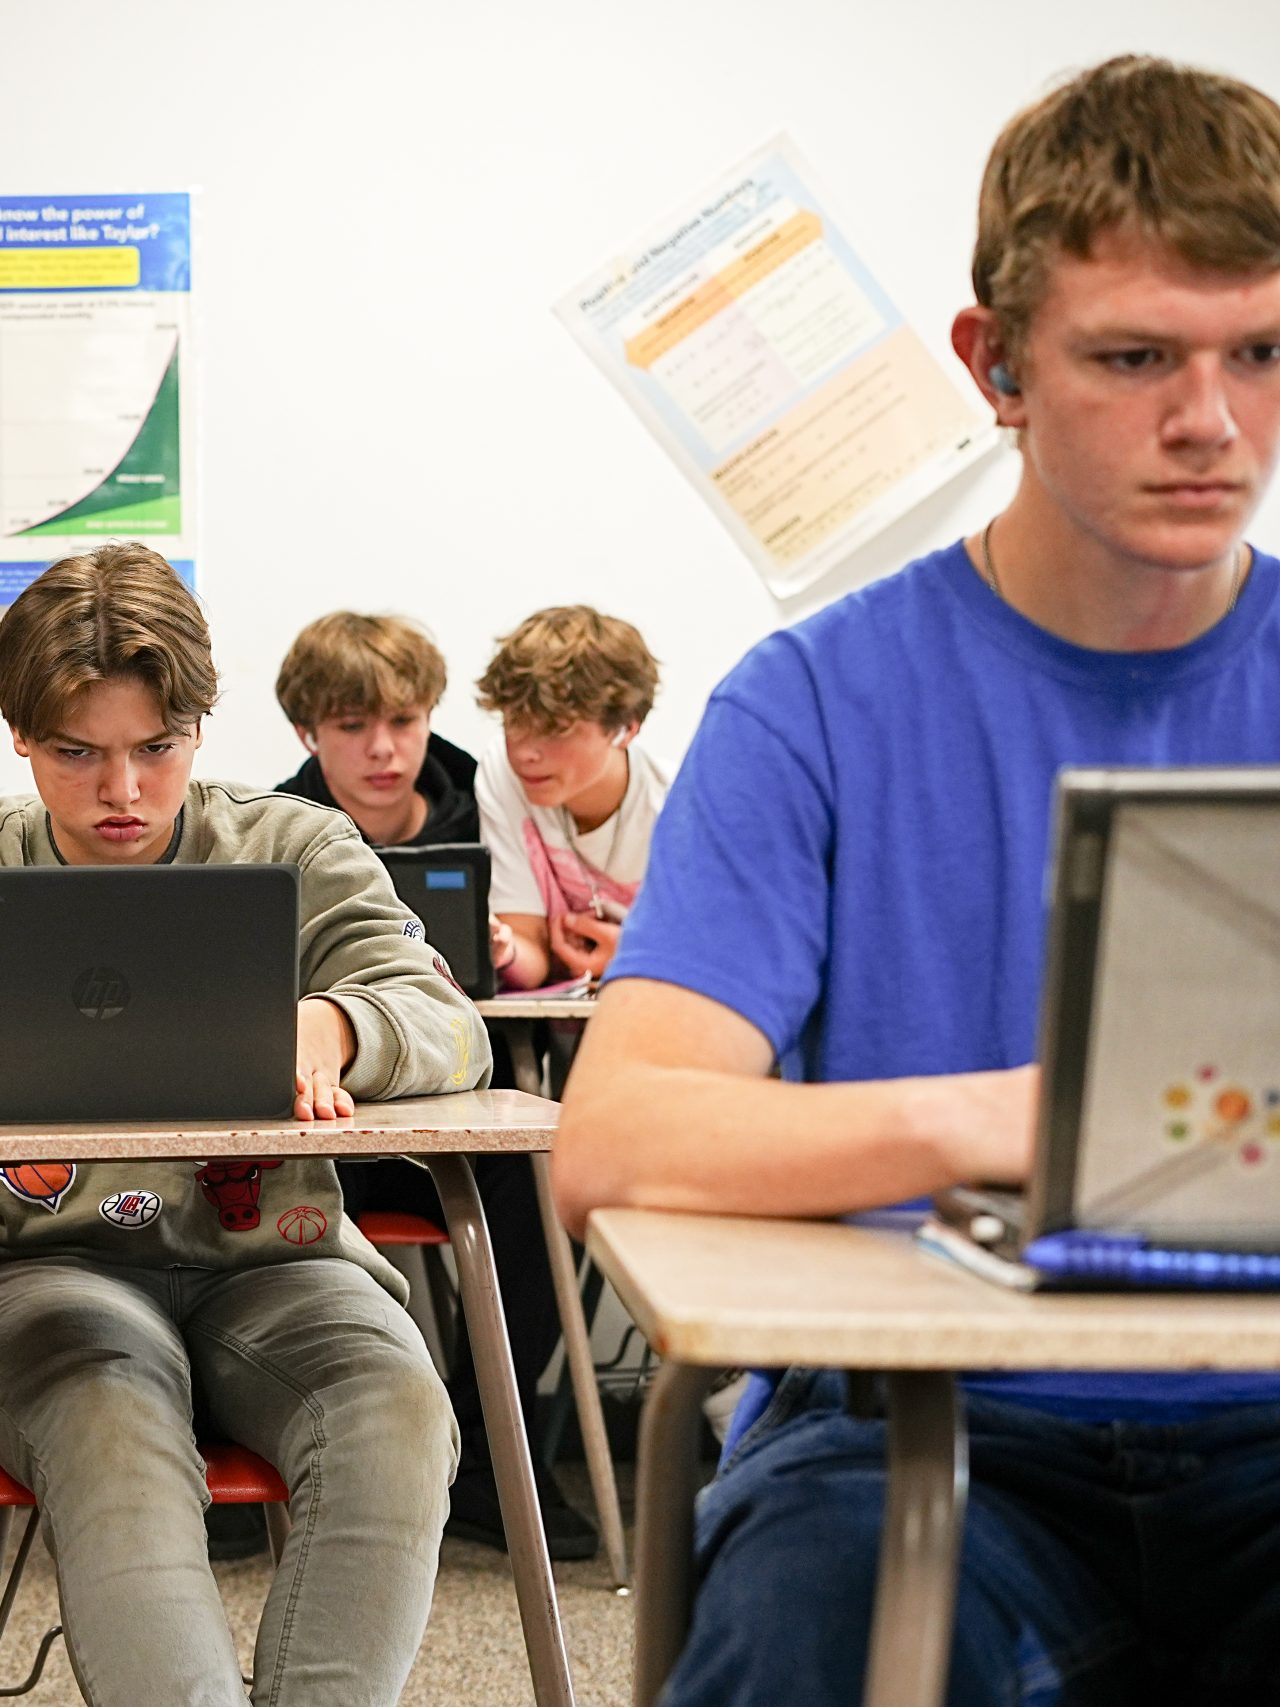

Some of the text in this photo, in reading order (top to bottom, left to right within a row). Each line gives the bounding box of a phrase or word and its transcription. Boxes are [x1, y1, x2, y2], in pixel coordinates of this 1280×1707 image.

[41, 205, 68, 222] the
[71, 208, 122, 225] power
[126, 203, 145, 220] of
[649, 217, 702, 257] Negative
[701, 177, 754, 218] Numbers
[6, 225, 67, 241] interest
[70, 225, 99, 240] like
[102, 222, 159, 243] Taylor?
